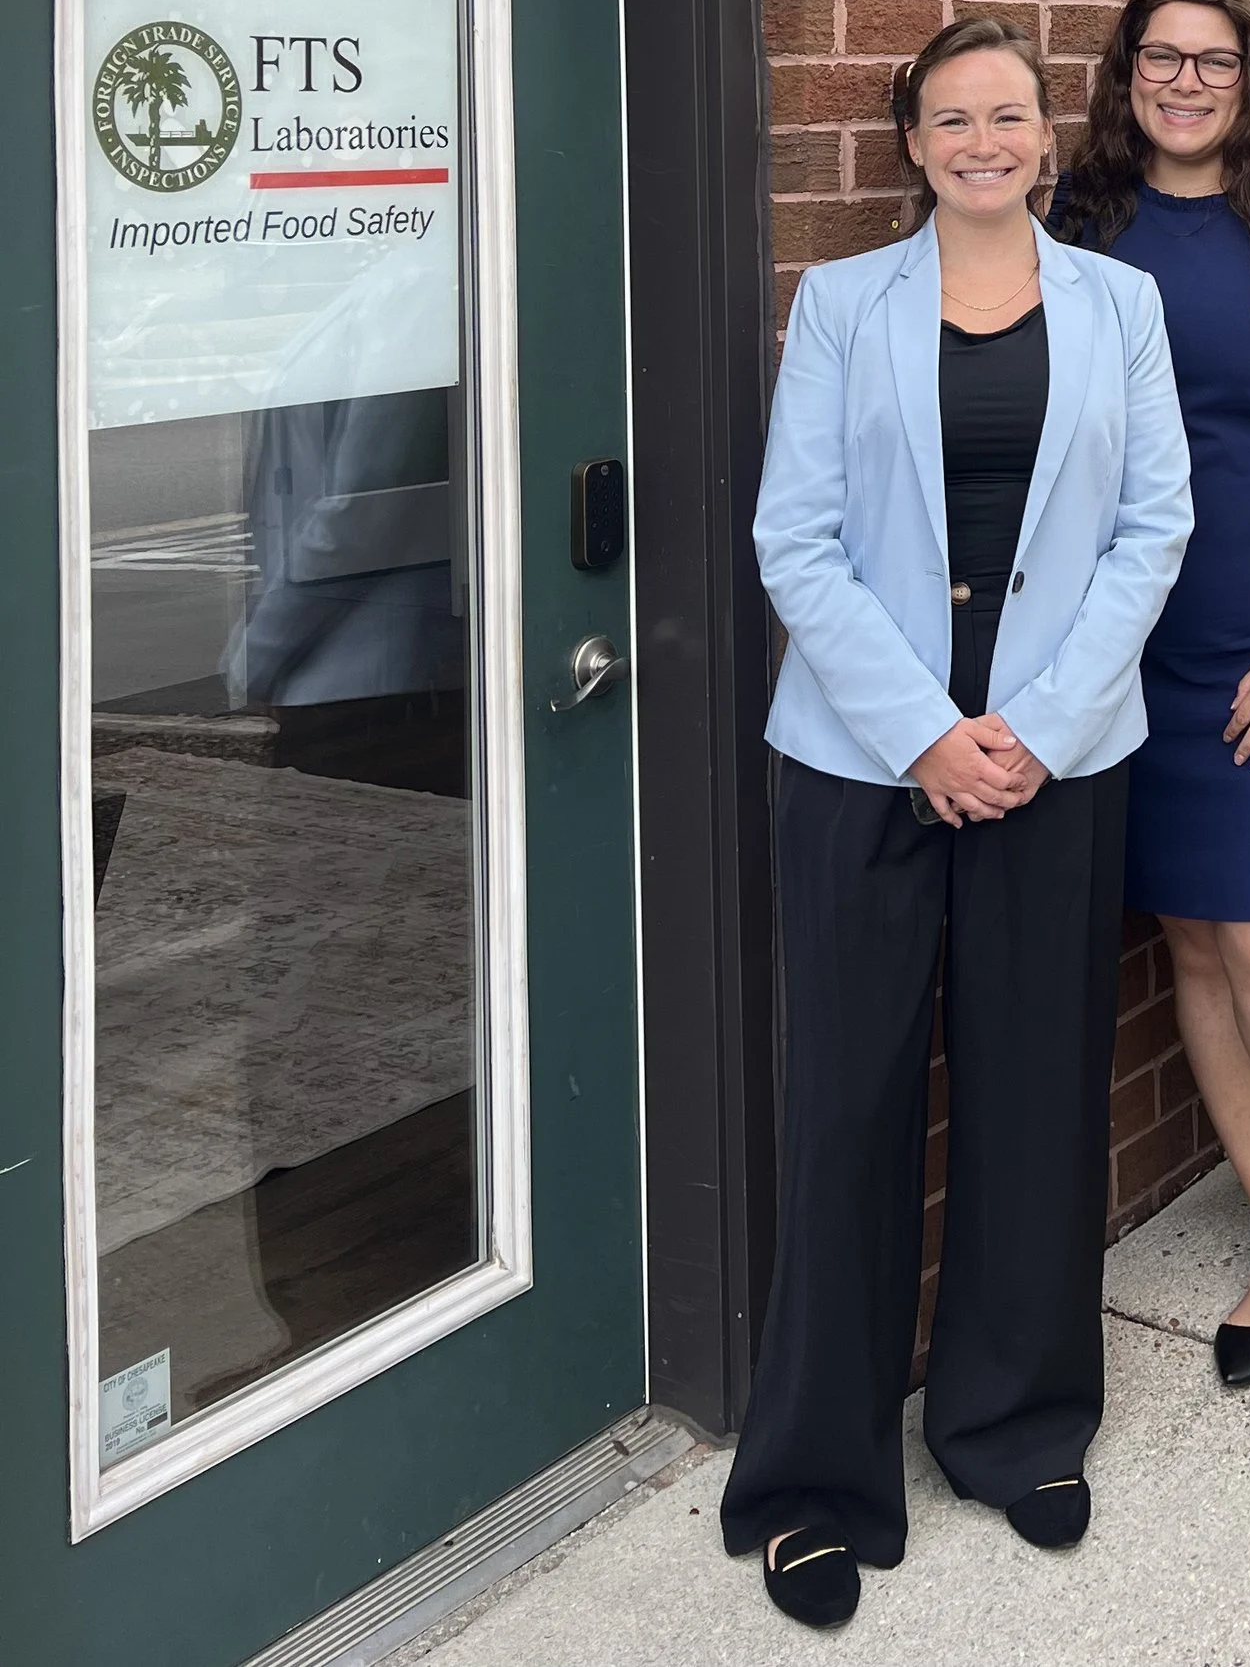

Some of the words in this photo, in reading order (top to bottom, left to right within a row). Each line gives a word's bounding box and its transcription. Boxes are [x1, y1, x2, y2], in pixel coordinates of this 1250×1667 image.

[96, 37, 138, 132] FOREIGN
[139, 25, 205, 50] TRADE
[205, 44, 239, 132] SERVICE
[249, 35, 363, 93] FTS
[250, 115, 449, 152] Laboratories
[109, 143, 226, 188] INSPECTIONS
[110, 210, 251, 256] Imported
[262, 205, 337, 240] Food
[347, 203, 436, 243] Safety
[103, 1377, 117, 1393] CITY
[118, 1374, 128, 1385] OF
[127, 1354, 166, 1382] CHESAPEAKE
[104, 1419, 138, 1442] BUSINESS
[139, 1404, 167, 1424] LICENSE
